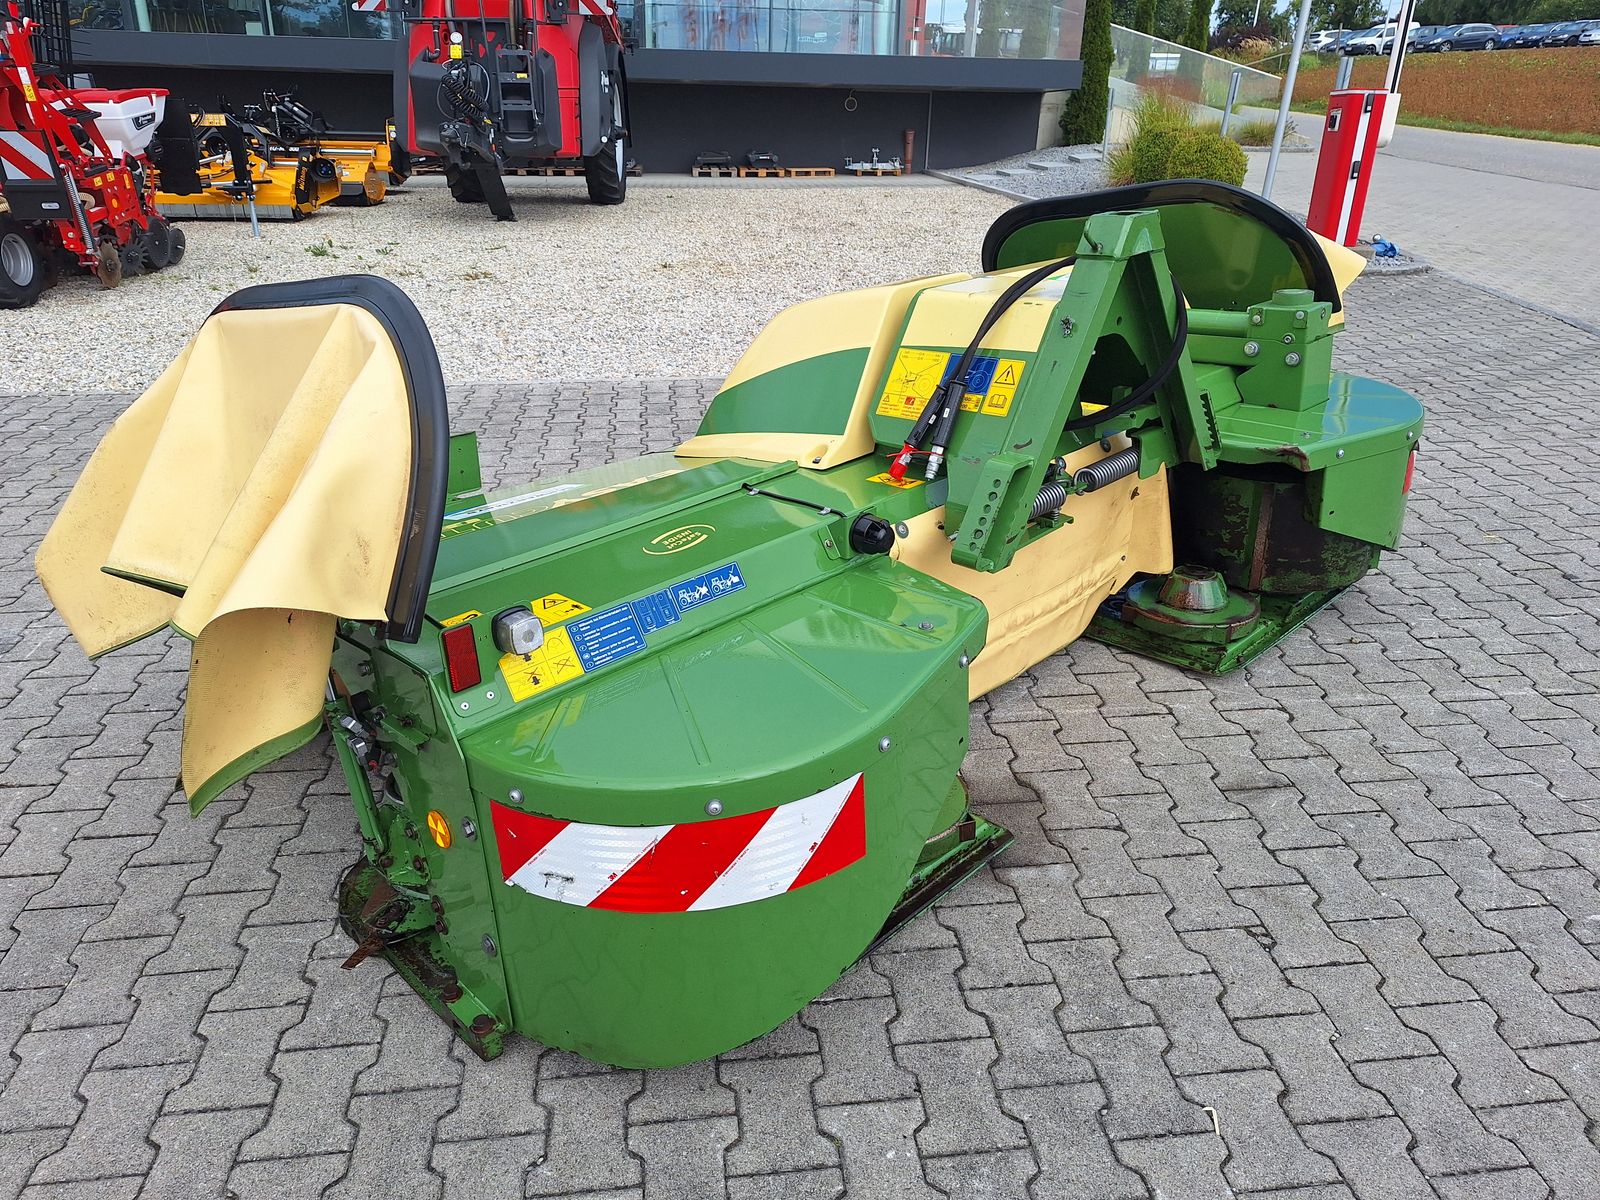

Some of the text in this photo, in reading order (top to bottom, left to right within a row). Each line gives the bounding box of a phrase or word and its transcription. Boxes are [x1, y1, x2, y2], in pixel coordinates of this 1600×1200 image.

[662, 529, 692, 545] INSIDE
[666, 531, 701, 549] SafeCut
[808, 842, 819, 853] 3M
[607, 872, 618, 881] 3M
